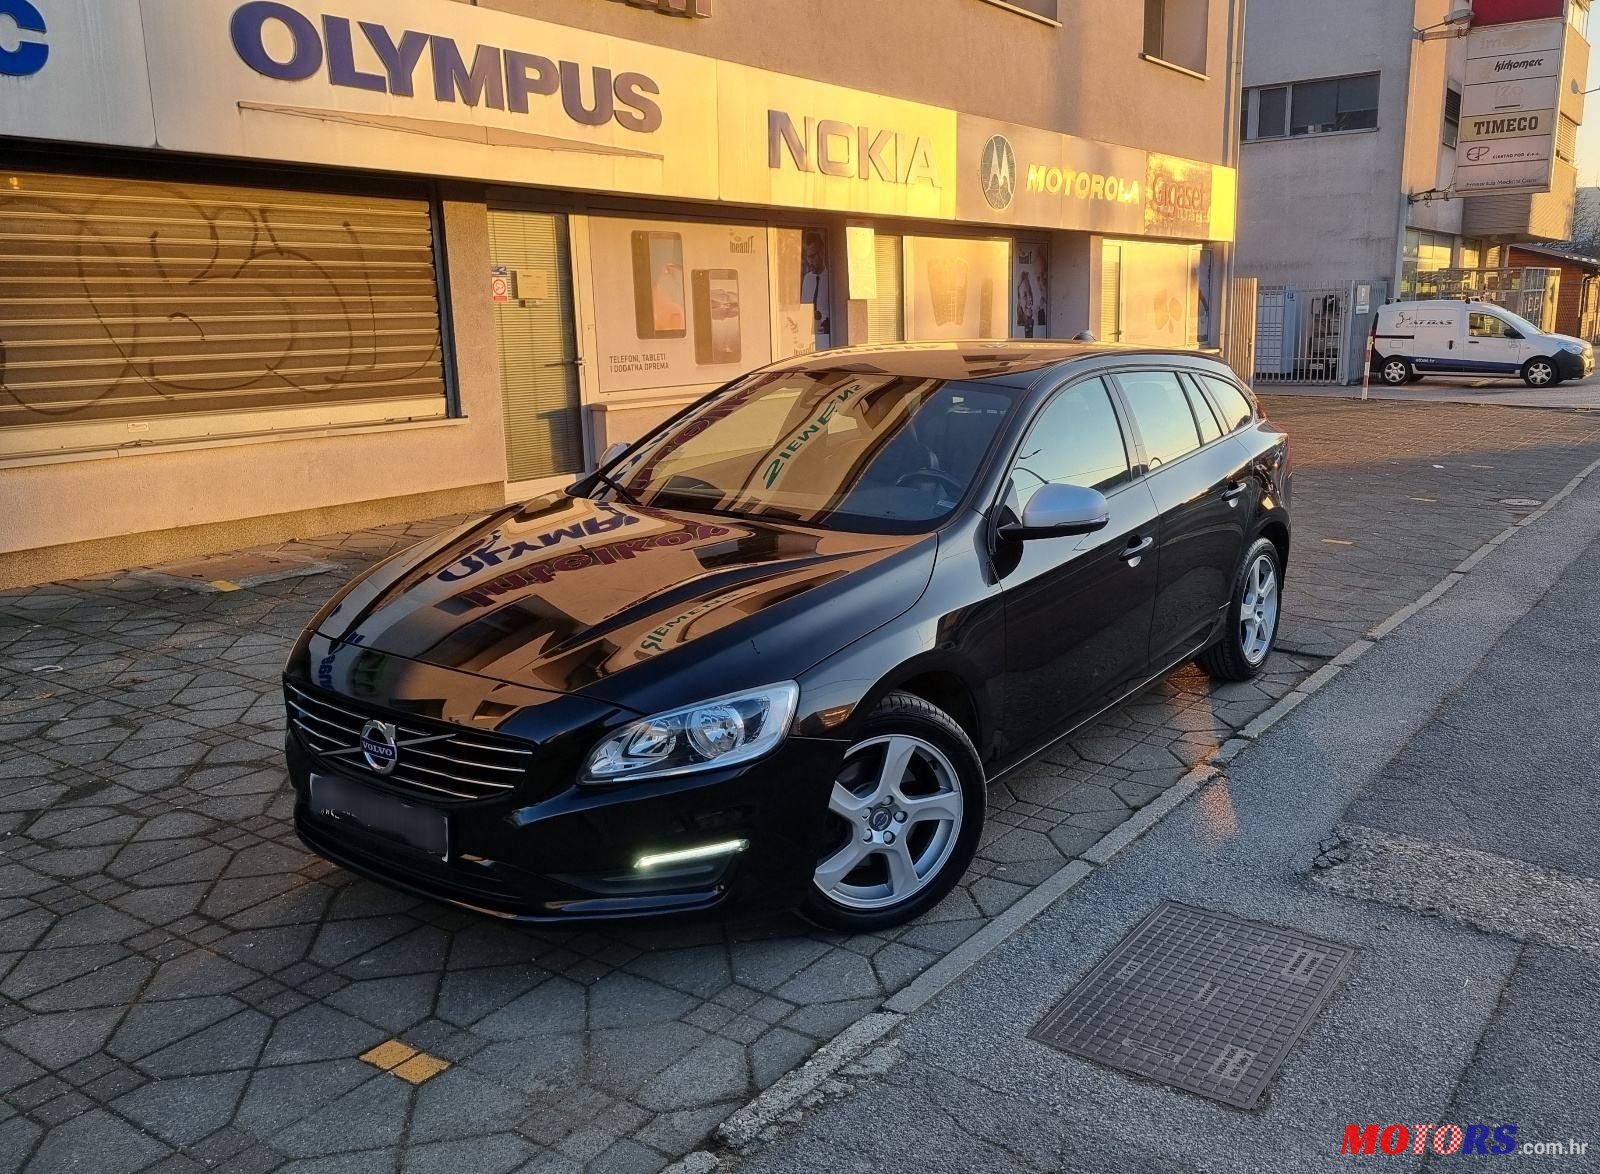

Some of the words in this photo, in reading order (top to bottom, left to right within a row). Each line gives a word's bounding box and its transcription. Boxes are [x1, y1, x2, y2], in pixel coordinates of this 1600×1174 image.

[229, 0, 663, 134] OLYMPUS
[1473, 116, 1539, 135] TIMECO
[767, 109, 943, 189] NOKIA
[1026, 163, 1140, 205] MOTOROLA
[608, 354, 640, 363] TELEFONI,
[641, 353, 666, 361] TABLETI
[613, 363, 643, 372] DODATNA
[644, 362, 669, 371] OPREMA
[362, 740, 393, 756] VOLVO
